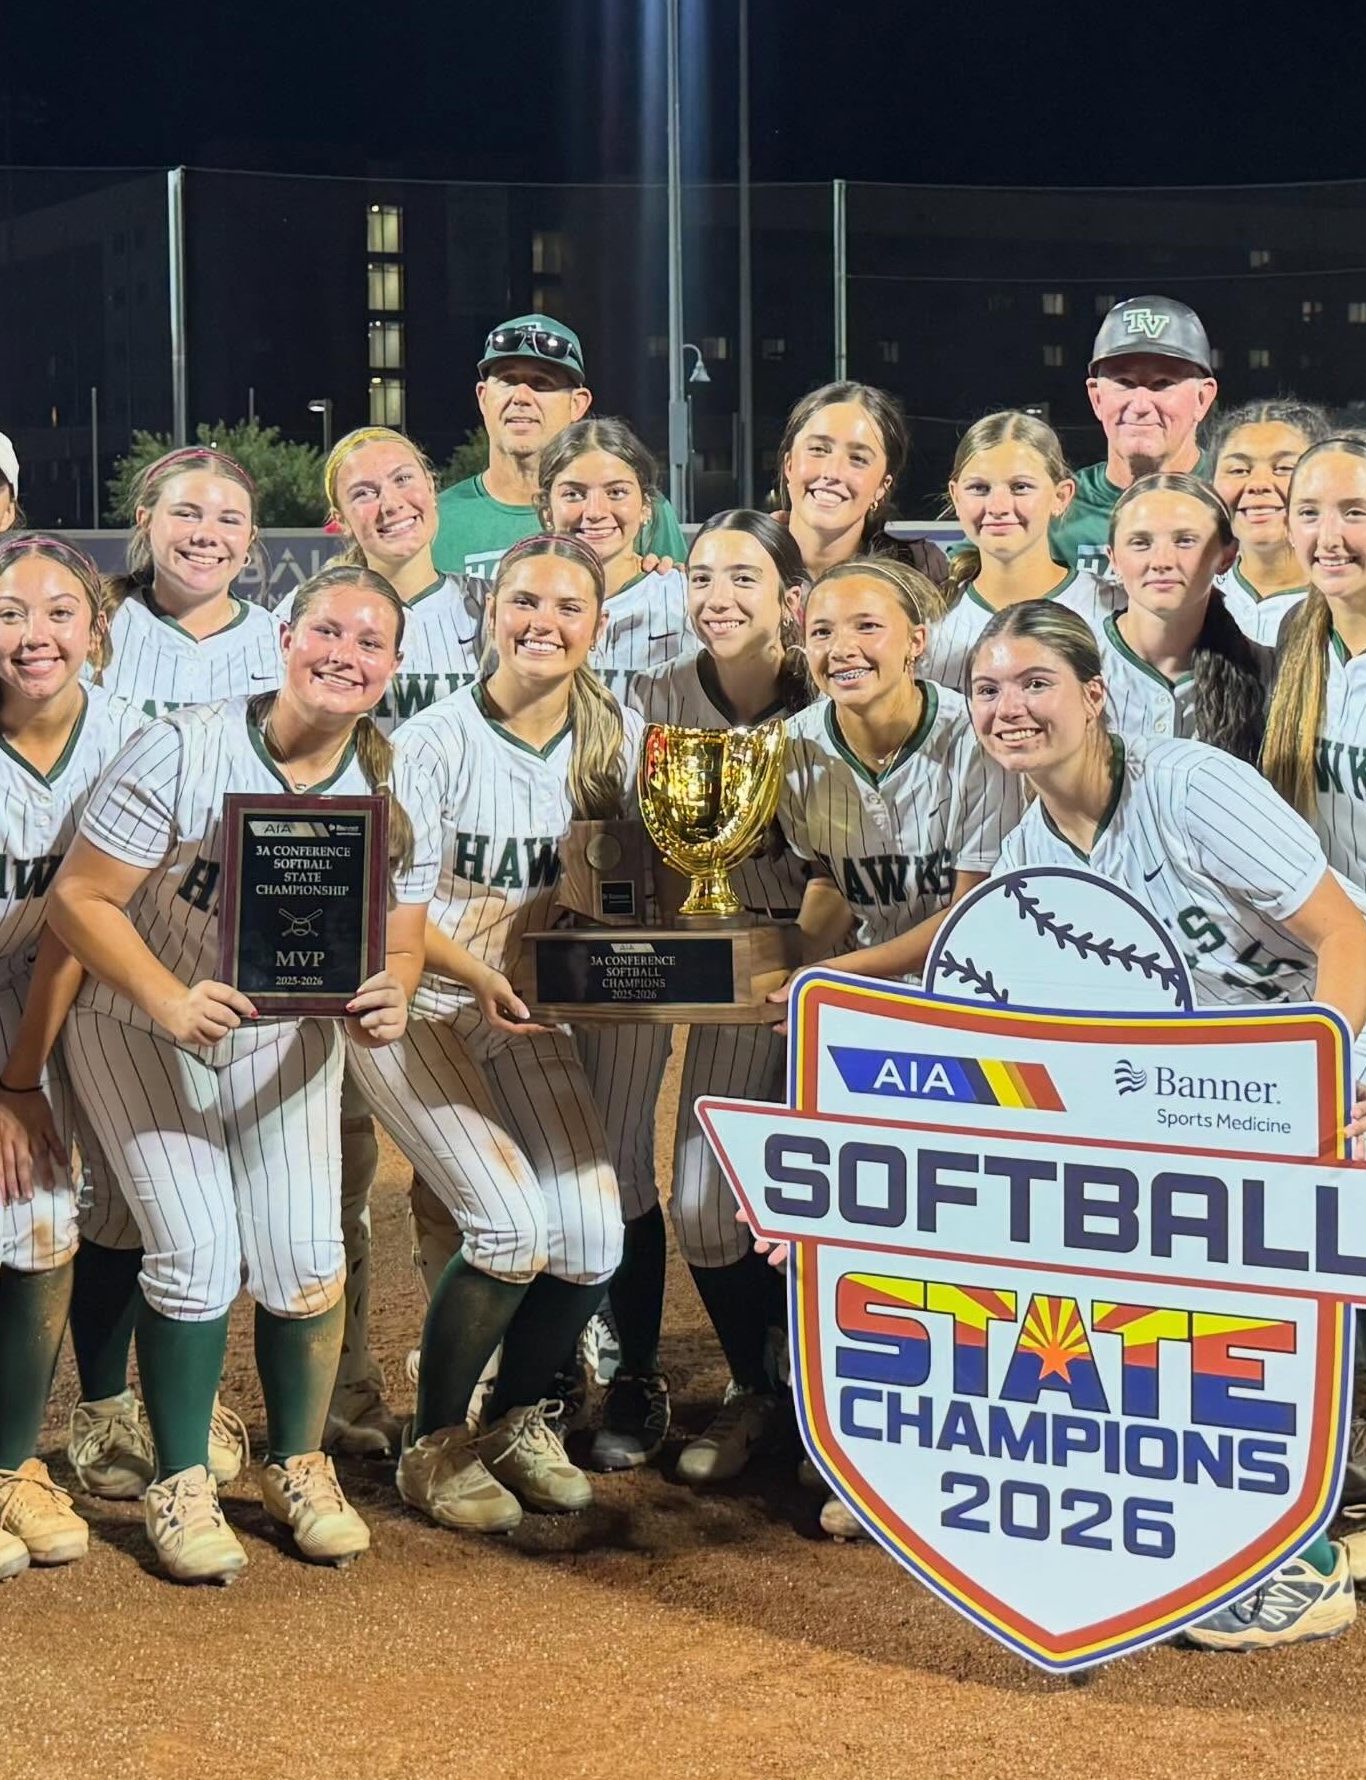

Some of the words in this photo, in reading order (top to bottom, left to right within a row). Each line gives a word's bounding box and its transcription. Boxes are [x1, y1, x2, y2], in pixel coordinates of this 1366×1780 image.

[1122, 308, 1171, 340] TV
[263, 823, 292, 834] AIA
[255, 845, 271, 857] 3A
[273, 846, 351, 857] CONFERENCE
[273, 859, 333, 870] SOFTBALL
[453, 832, 562, 888] HAW
[283, 872, 322, 883] STATE
[840, 848, 956, 907] AWKS
[255, 885, 350, 896] CHAMPIONSHIP
[275, 950, 325, 967] MVP
[589, 956, 604, 966] 3A
[605, 956, 676, 966] CONFERENCE
[606, 967, 662, 978] SOFTBALL
[275, 976, 324, 986] 2025-2026
[601, 978, 666, 989] CHAMPIONS
[611, 989, 657, 999] 2025-2026
[872, 1058, 956, 1097] AIA
[1157, 1107, 1213, 1129] Sports
[1216, 1113, 1292, 1135] Medicine
[835, 1271, 1298, 1437] STATE
[838, 1385, 1291, 1497] CHAMPIONS
[939, 1471, 1177, 1561] 2026
